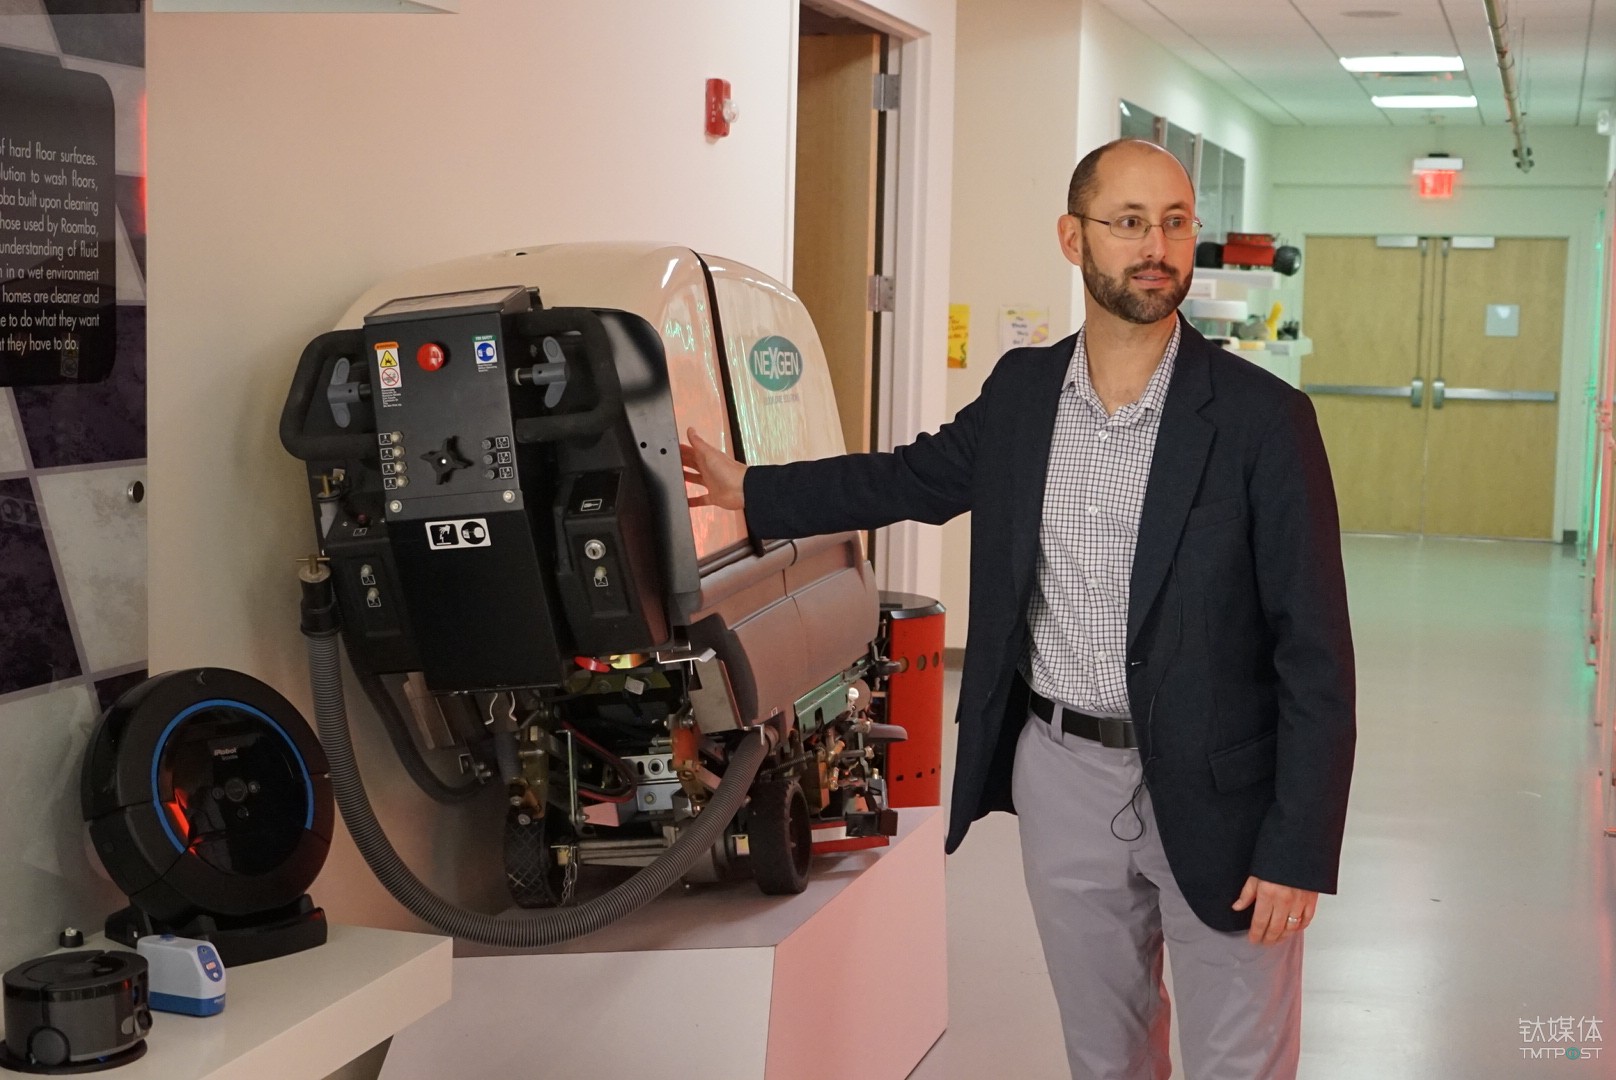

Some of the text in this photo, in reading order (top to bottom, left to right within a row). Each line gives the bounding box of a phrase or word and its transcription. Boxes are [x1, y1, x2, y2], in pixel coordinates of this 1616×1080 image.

[9, 138, 32, 159] hard
[35, 141, 57, 161] floor
[60, 145, 98, 166] surfaces.
[30, 169, 40, 183] to
[43, 168, 68, 186] wash
[71, 169, 98, 192] floors,
[18, 188, 37, 207] built
[39, 197, 62, 213] upon
[63, 192, 99, 216] cleaning
[23, 214, 45, 232] used
[46, 214, 59, 237] by
[60, 217, 99, 238] Roomba,
[0, 236, 99, 261] understanding of fluid
[6, 262, 15, 279] in
[17, 268, 25, 279] a
[27, 266, 44, 280] wet
[46, 264, 99, 281] environment
[2, 284, 100, 304] homes are cleaner and
[8, 313, 18, 327] to
[20, 309, 33, 327] do
[34, 309, 57, 327] what
[59, 309, 77, 332] they
[79, 313, 100, 327] want
[7, 333, 27, 356] they
[29, 333, 51, 351] have
[53, 336, 63, 350] to
[64, 332, 79, 350] do.
[753, 346, 799, 380] NEXGEN
